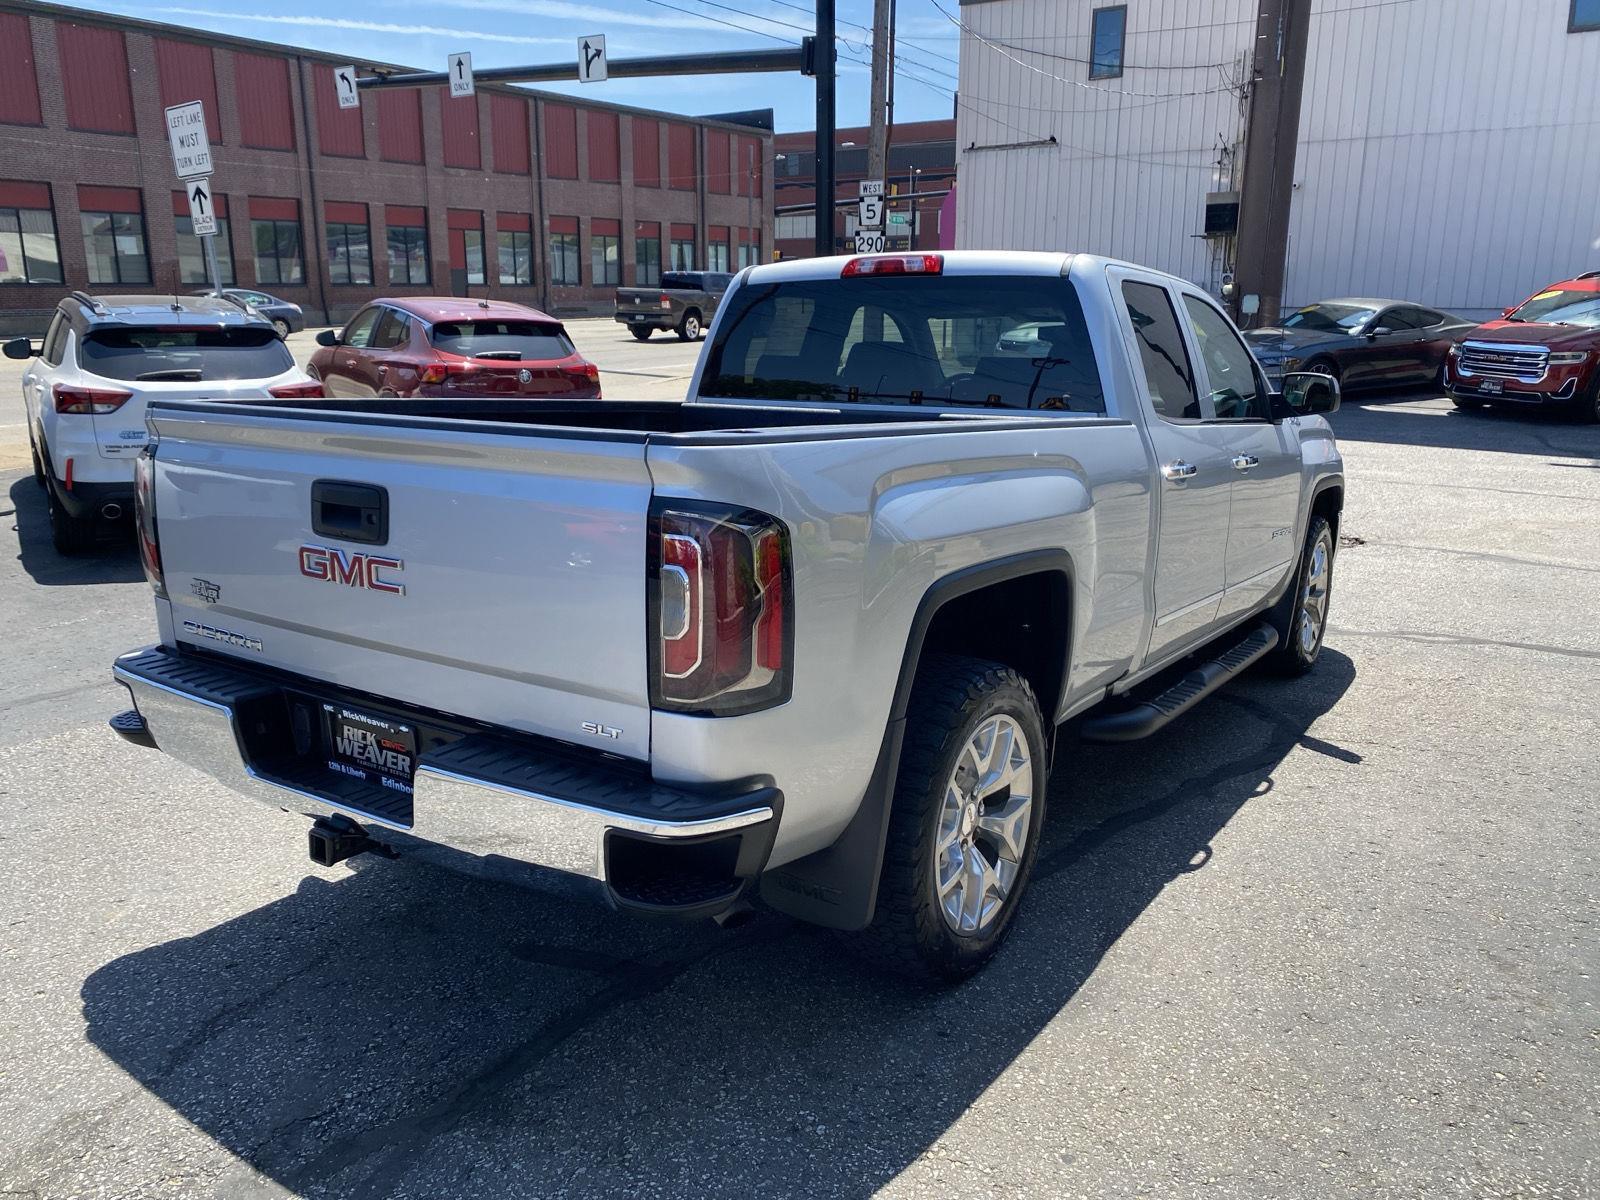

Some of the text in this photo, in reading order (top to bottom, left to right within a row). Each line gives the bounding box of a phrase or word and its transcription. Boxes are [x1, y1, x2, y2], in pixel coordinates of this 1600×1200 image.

[454, 81, 470, 92] ONLY
[341, 96, 355, 104] ONLY
[170, 111, 201, 129] LEFT LANE
[178, 132, 199, 149] MUST
[177, 153, 209, 169] TURN LEFT
[862, 183, 882, 193] WEST
[866, 203, 876, 220] 5
[194, 215, 213, 226] BLACK
[857, 236, 883, 253] 290
[299, 543, 407, 596] GMC
[183, 620, 264, 652] SIERRA
[342, 709, 389, 730] RickWeaver
[343, 724, 377, 746] RICK
[581, 720, 625, 740] SLT
[336, 736, 411, 774] WEAVER
